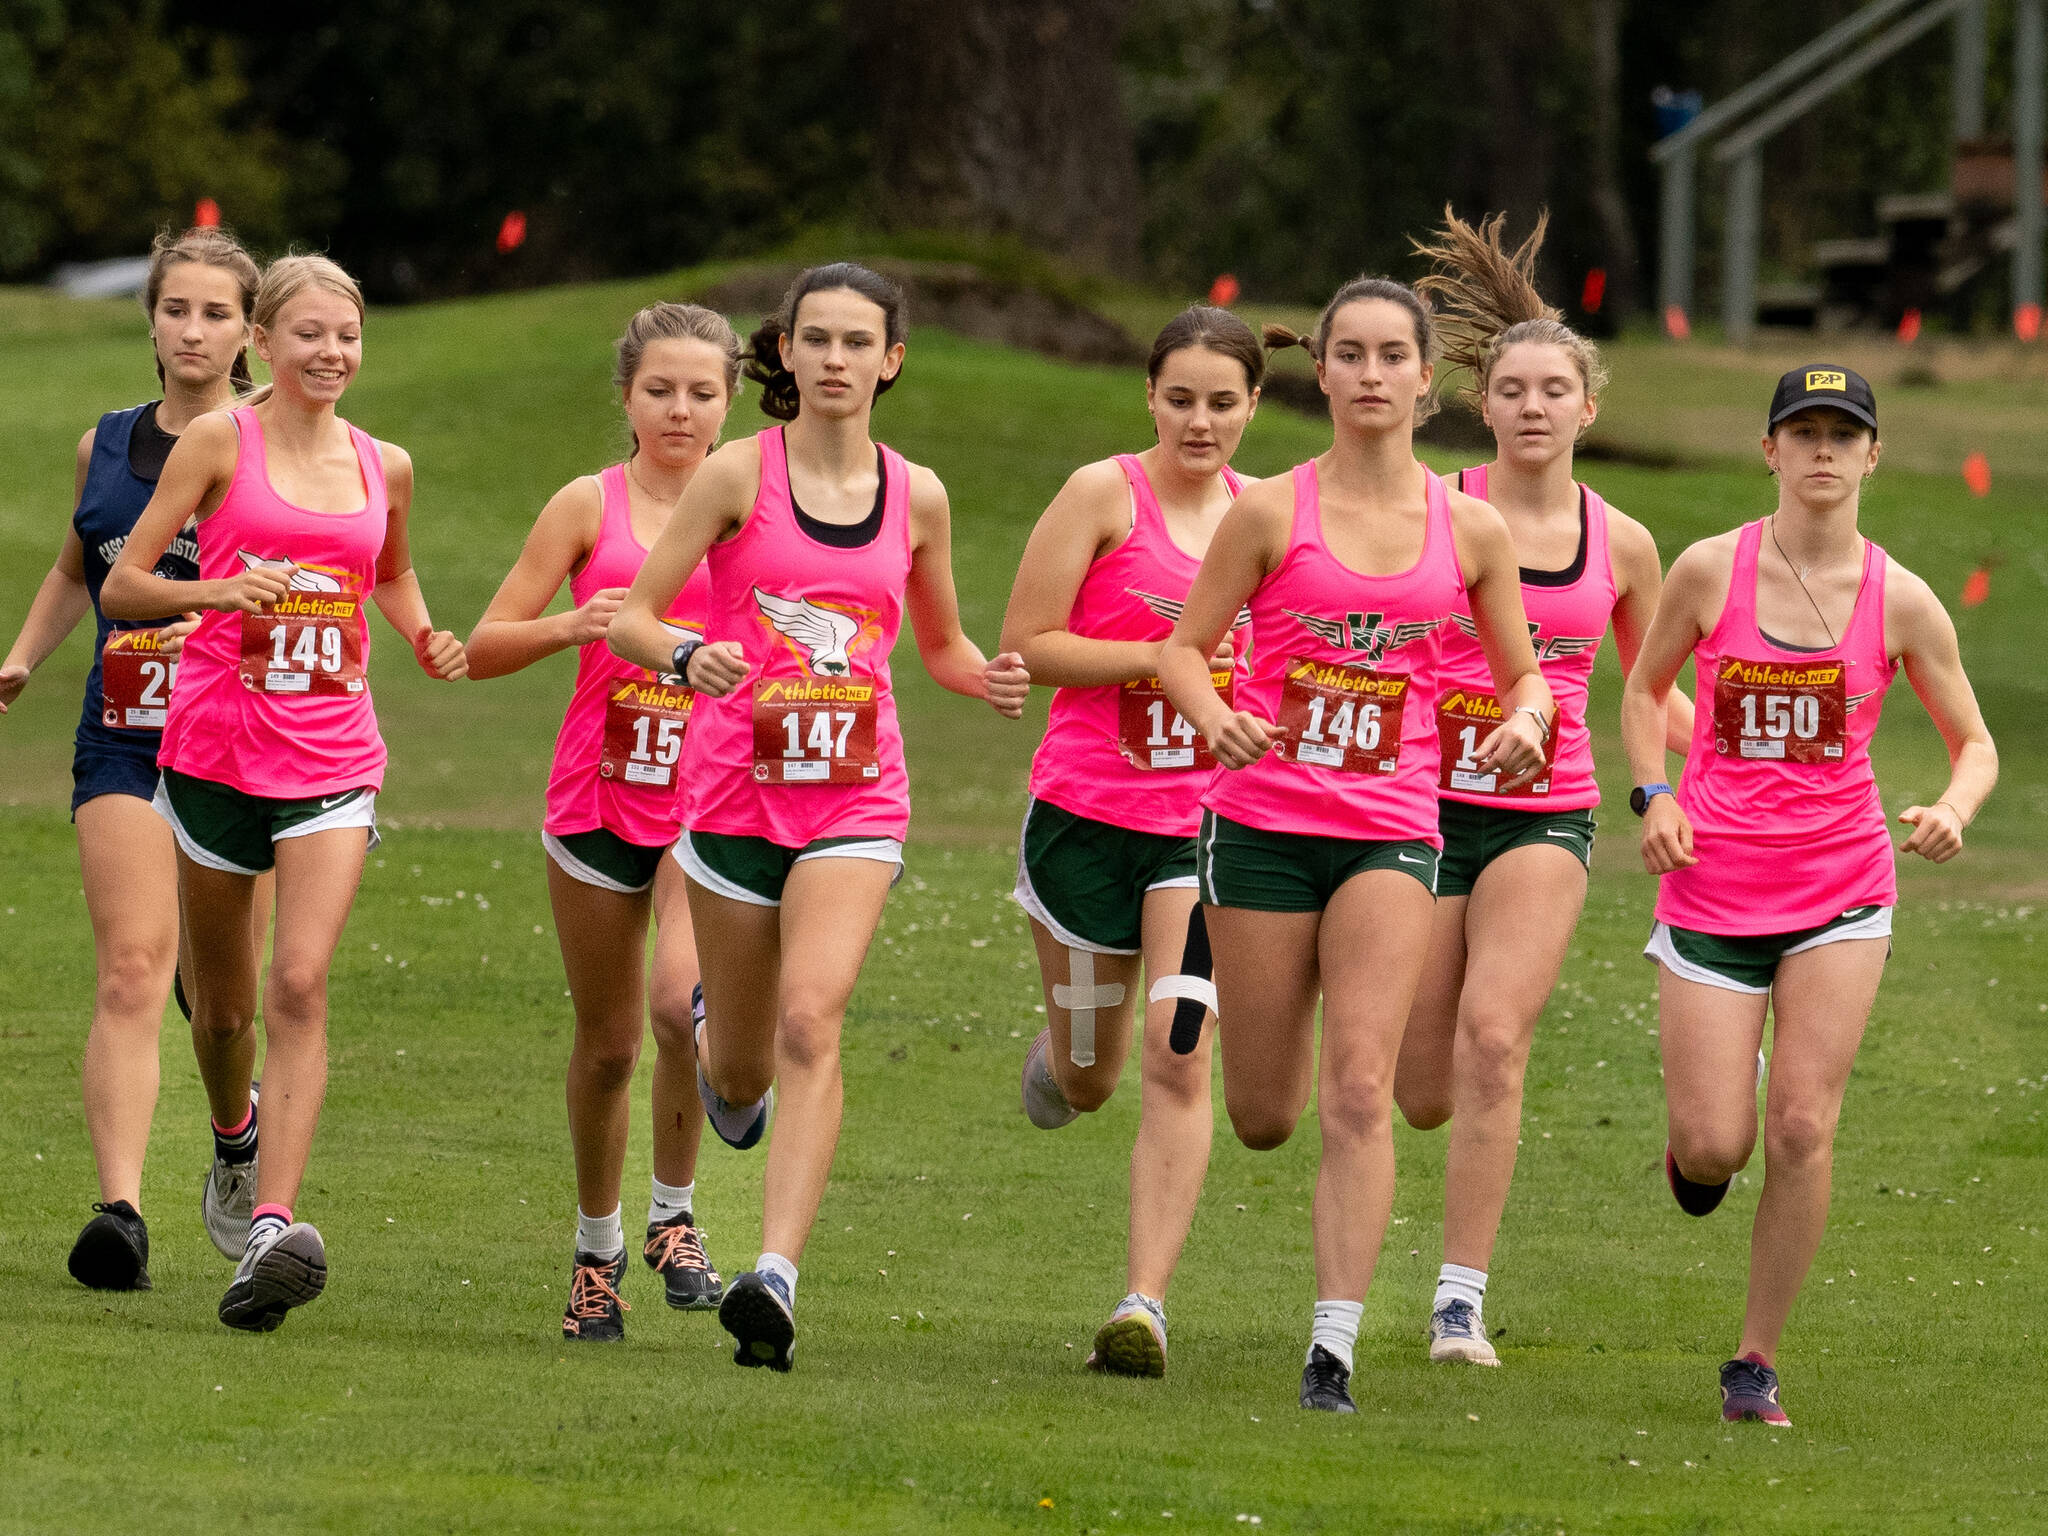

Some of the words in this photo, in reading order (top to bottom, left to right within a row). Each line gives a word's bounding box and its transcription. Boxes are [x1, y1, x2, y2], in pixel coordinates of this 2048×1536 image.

[1809, 373, 1842, 386] P2P
[98, 535, 129, 565] CASC
[254, 594, 334, 615] thletic
[268, 625, 342, 673] 149
[1146, 701, 1196, 746] 14
[1302, 696, 1381, 750] 146
[1441, 693, 1502, 718] Athle
[1740, 694, 1819, 738] 150
[630, 716, 684, 765] 15
[782, 711, 856, 758] 147
